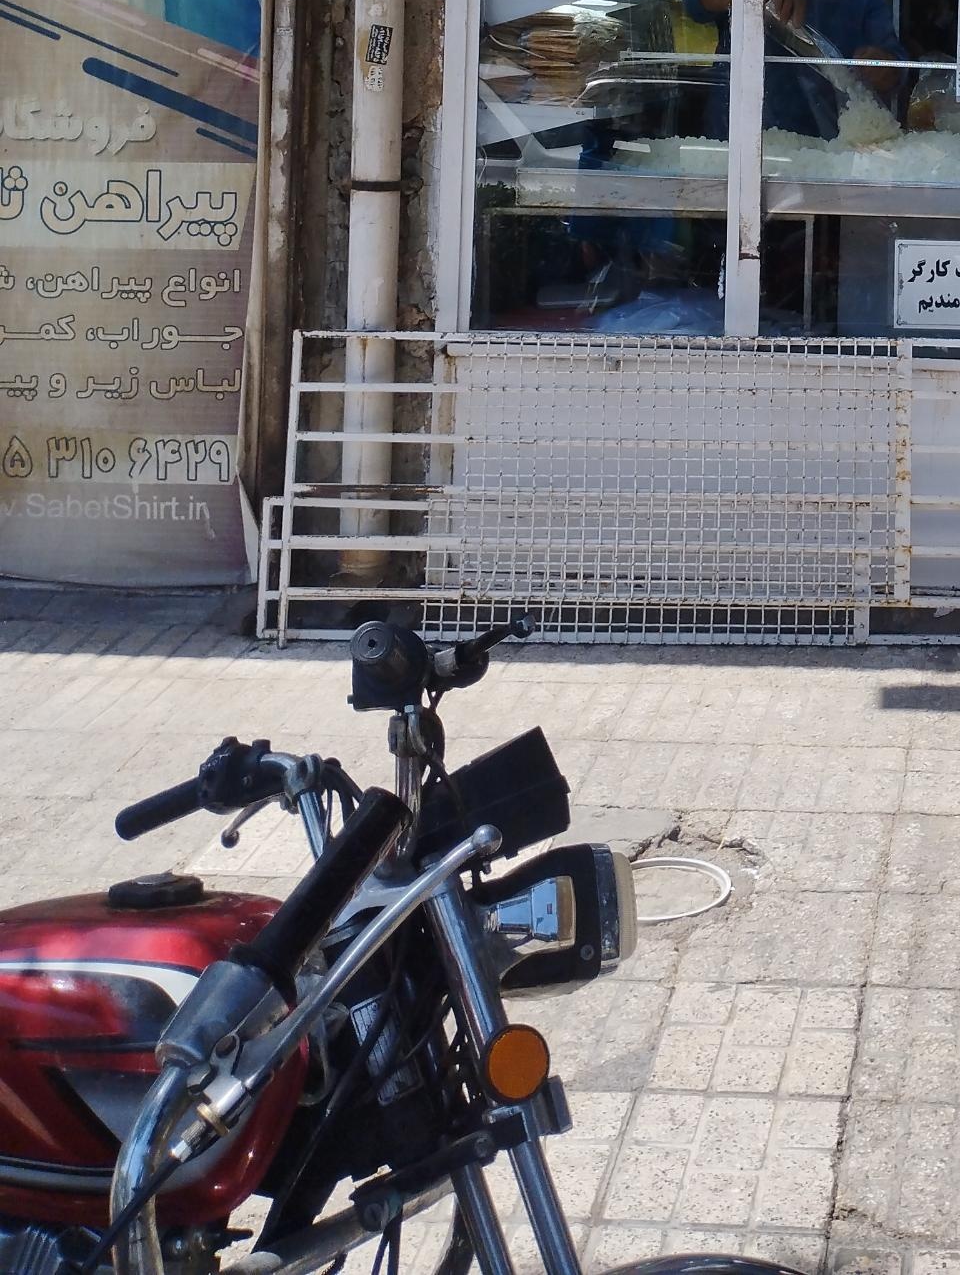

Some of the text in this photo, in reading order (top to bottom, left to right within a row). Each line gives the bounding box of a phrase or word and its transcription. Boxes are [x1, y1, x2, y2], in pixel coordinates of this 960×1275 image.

[0, 95, 157, 155] فروشگا
[40, 169, 238, 246] پیراهن
[161, 267, 242, 307] انواع
[907, 259, 951, 283] کارگر
[48, 372, 67, 398] و
[76, 366, 140, 400] زیر
[150, 367, 242, 400] لباس
[46, 436, 116, 479] ۳۱۰
[128, 436, 230, 483] ۶۴۲۹
